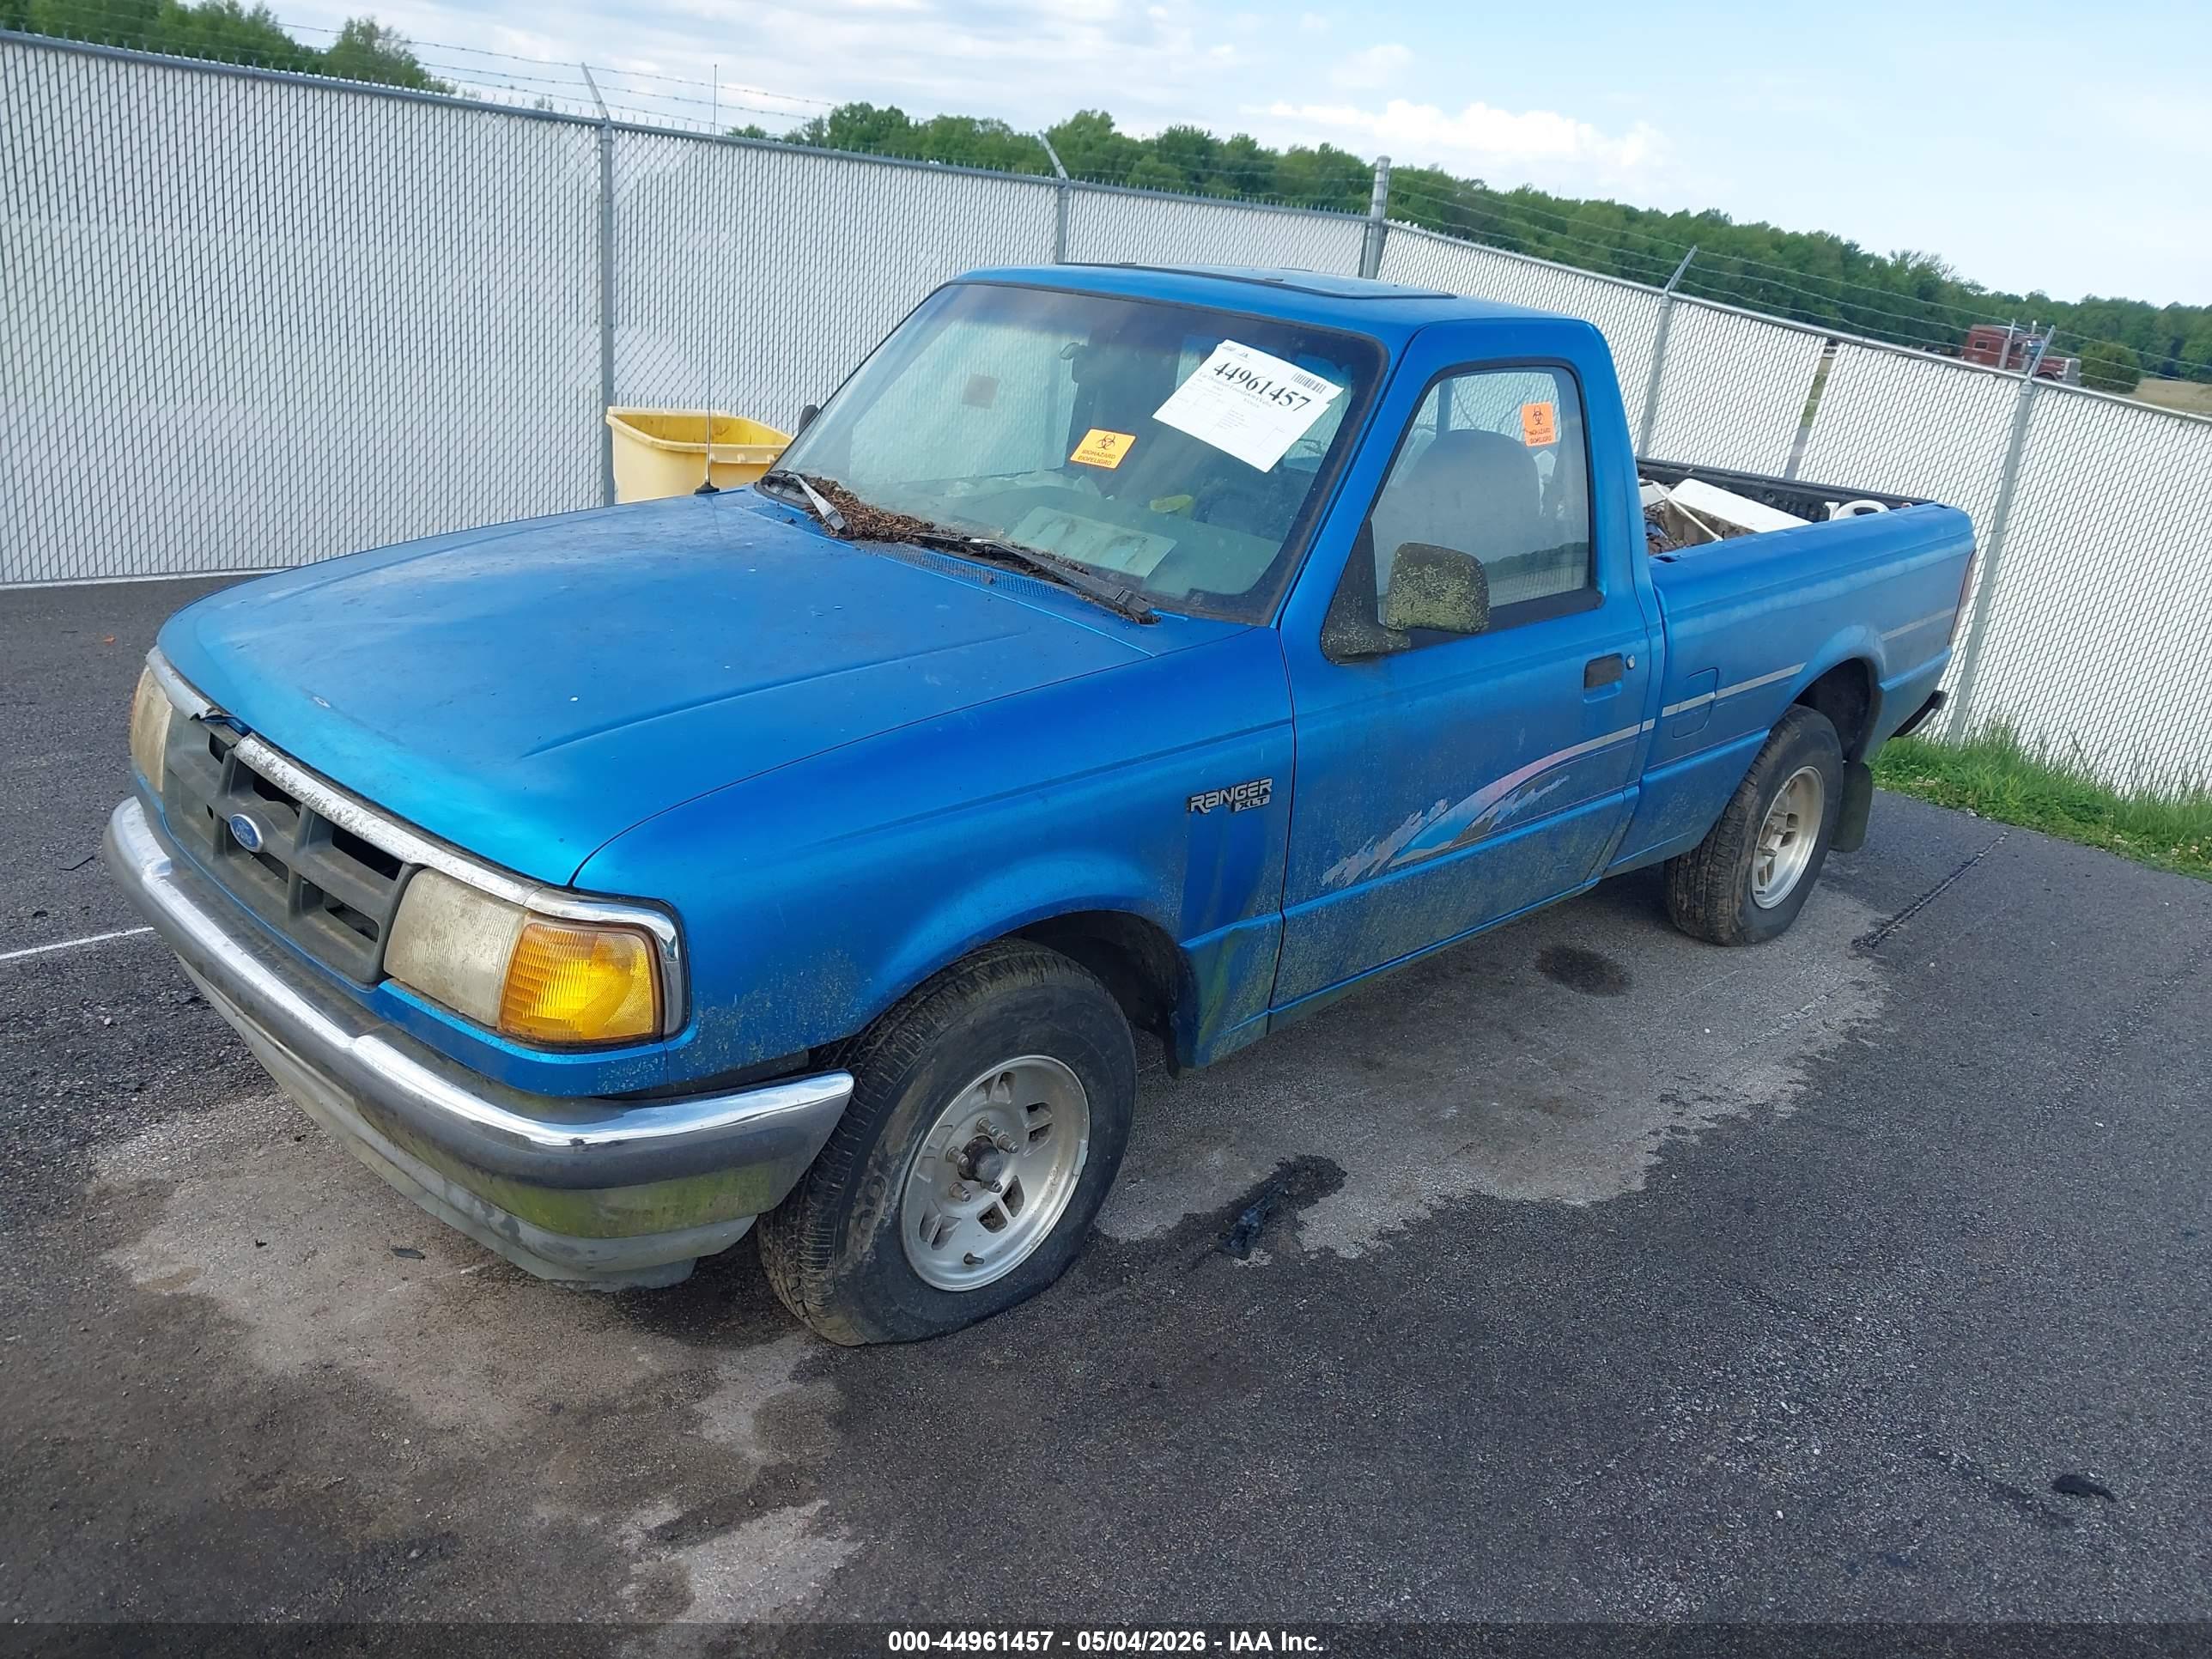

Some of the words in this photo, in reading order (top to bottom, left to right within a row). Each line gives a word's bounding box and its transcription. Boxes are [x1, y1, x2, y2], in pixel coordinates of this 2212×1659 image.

[1213, 362, 1312, 412] 44961457
[1078, 455, 1112, 465] BIOPELIGRO
[1081, 449, 1116, 459] BIOHAZARD
[1189, 777, 1273, 814] RANGER
[1238, 795, 1268, 810] XLT
[235, 821, 254, 846] Ford
